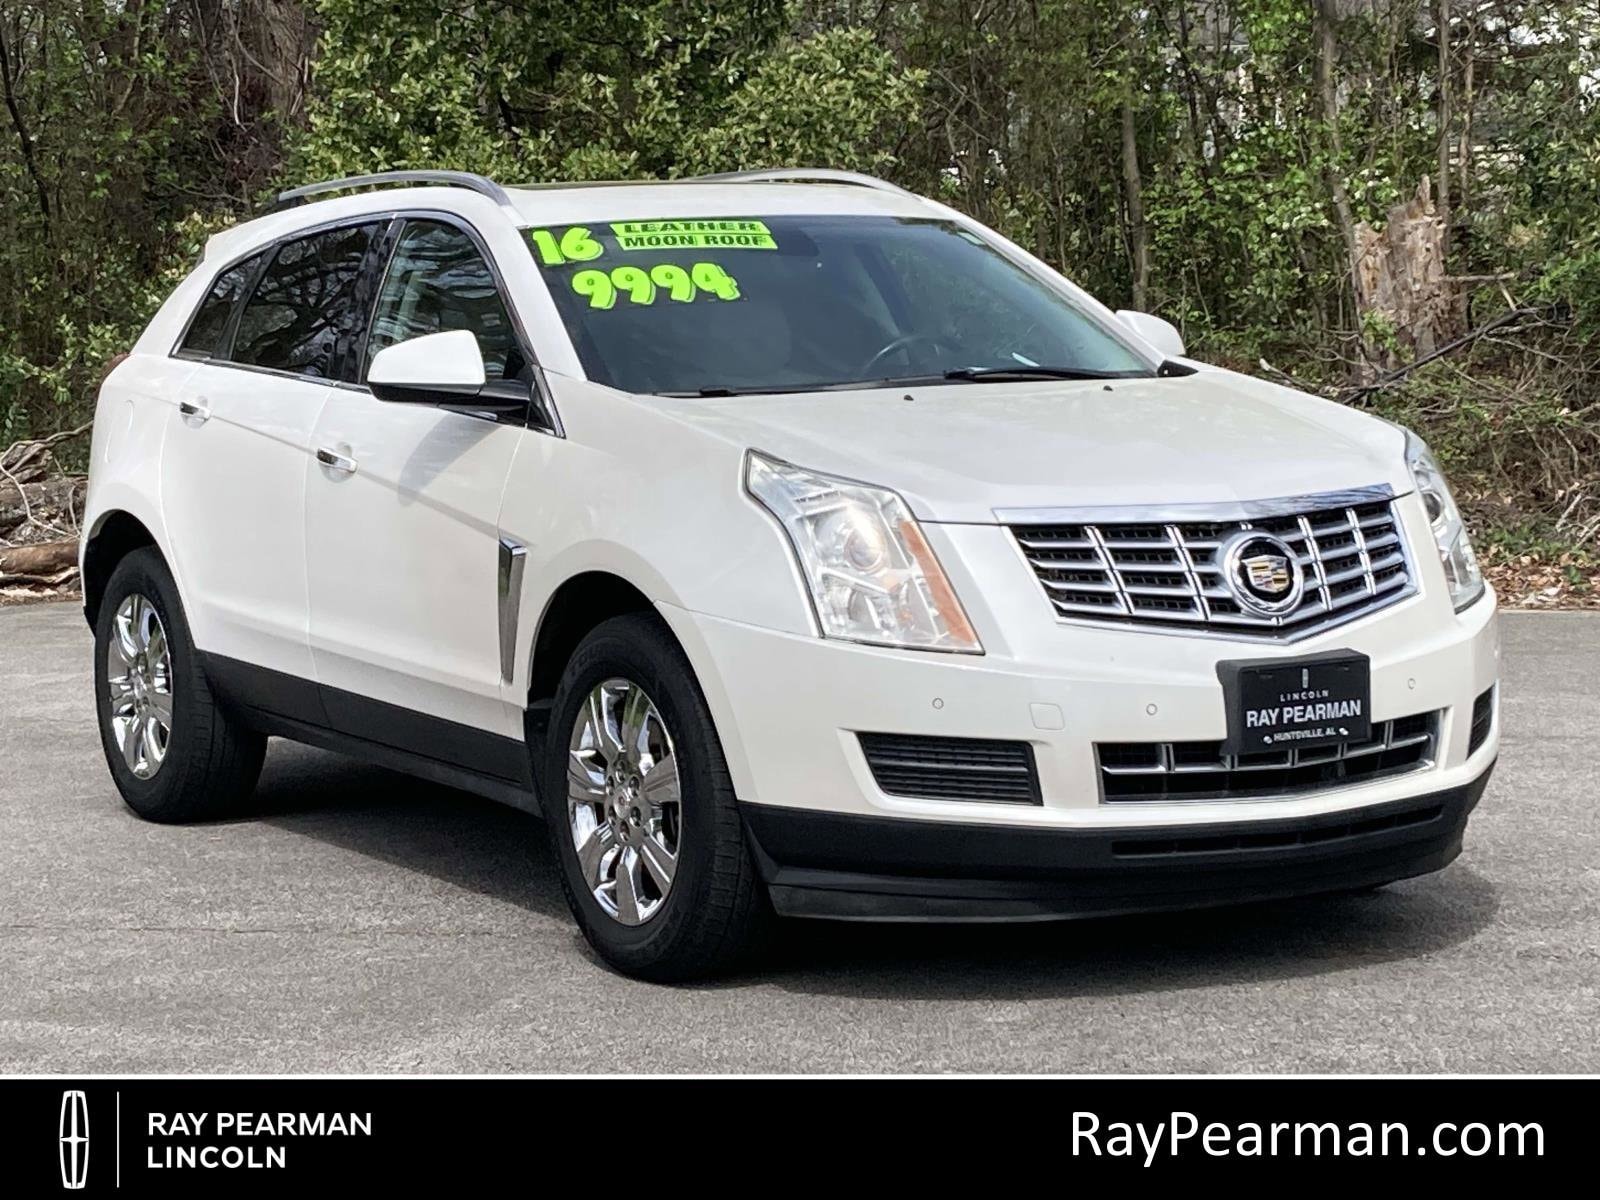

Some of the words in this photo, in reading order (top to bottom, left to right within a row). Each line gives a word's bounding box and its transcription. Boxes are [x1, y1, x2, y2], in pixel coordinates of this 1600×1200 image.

[623, 221, 761, 234] LEATHER
[532, 227, 604, 265] 16
[624, 235, 698, 248] MOON
[704, 234, 769, 246] ROOF
[571, 262, 741, 310] 9994
[1279, 689, 1330, 702] LINCOLN
[1246, 707, 1280, 728] RAY
[1282, 699, 1362, 724] PEARMAN
[1325, 727, 1337, 736] AL
